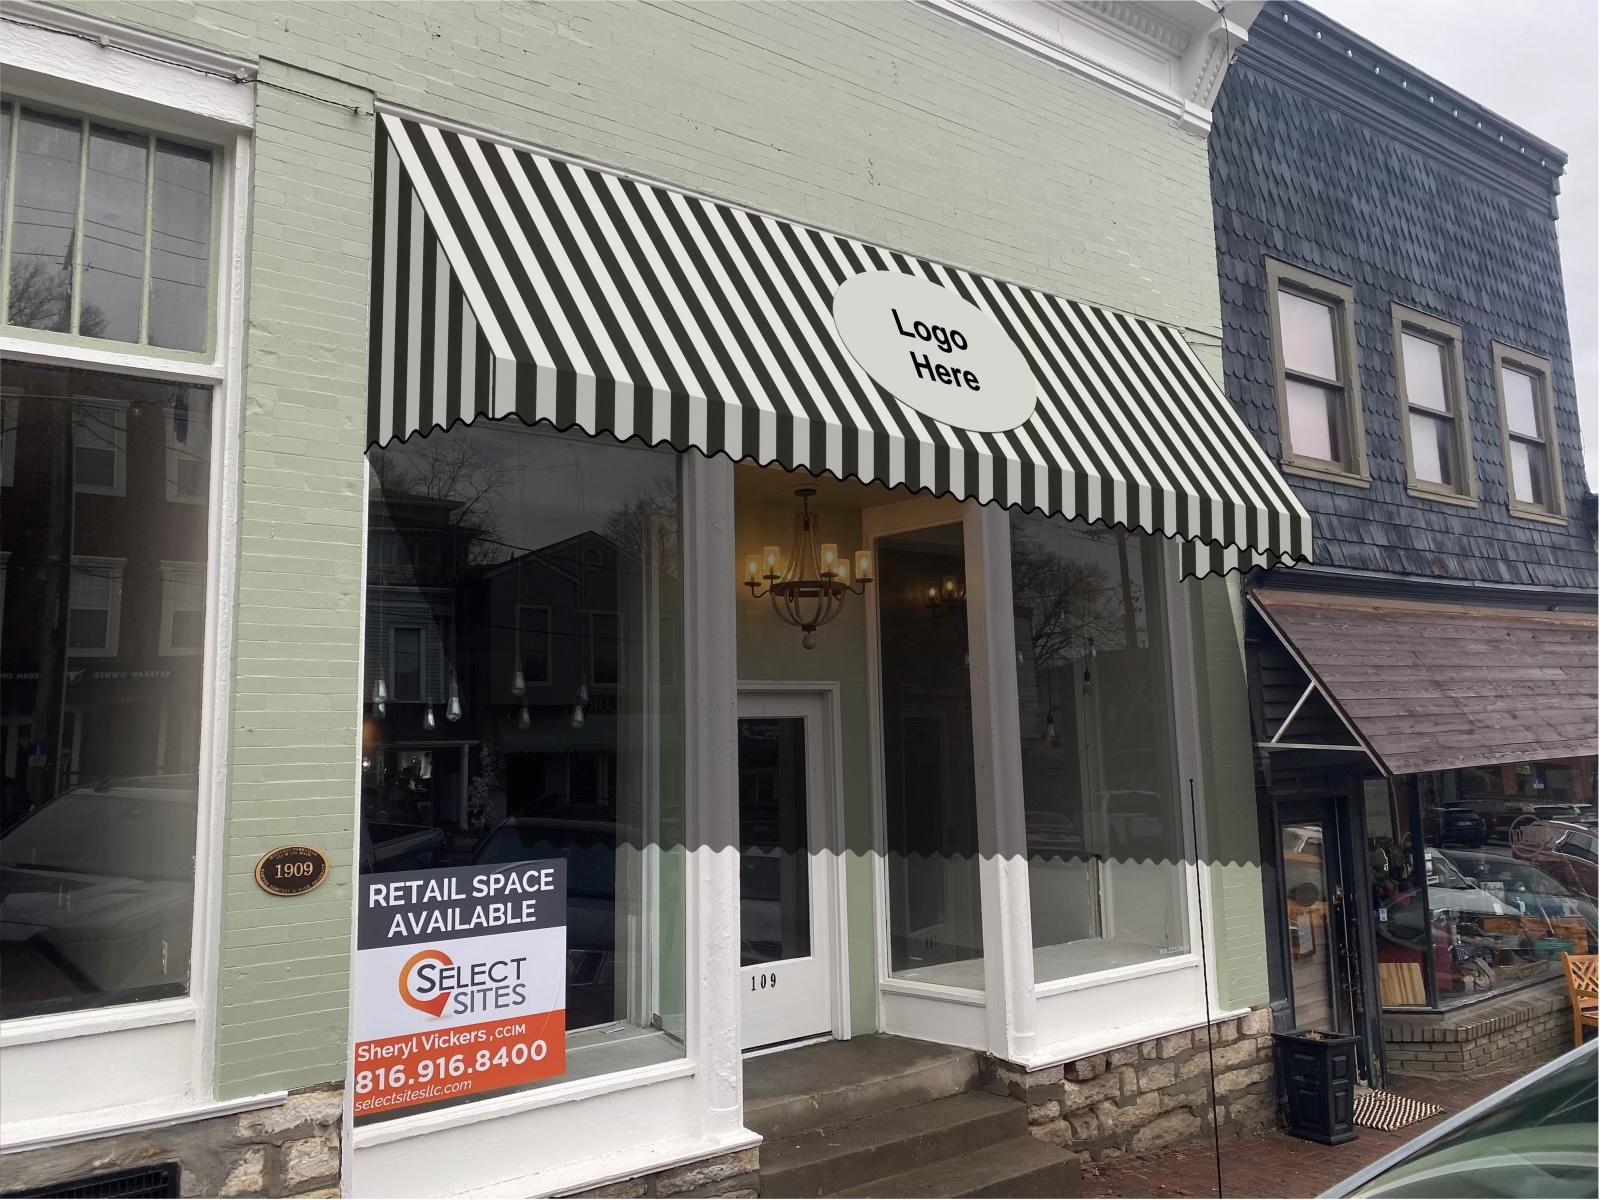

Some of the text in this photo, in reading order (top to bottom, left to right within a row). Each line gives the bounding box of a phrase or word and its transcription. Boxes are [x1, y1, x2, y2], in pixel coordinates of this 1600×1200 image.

[891, 308, 968, 353] Logo
[909, 351, 981, 391] Here
[275, 861, 313, 879] 1909
[369, 868, 555, 908] RETAIL SPACE
[387, 899, 537, 938] AVAILABLE
[416, 957, 527, 994] SELECT
[751, 972, 777, 991] 109
[453, 983, 527, 1015] SITES
[355, 1039, 547, 1094] 816.916.8400
[357, 1037, 418, 1062] Sheryl
[354, 1079, 472, 1112] selectsitesllc.com
